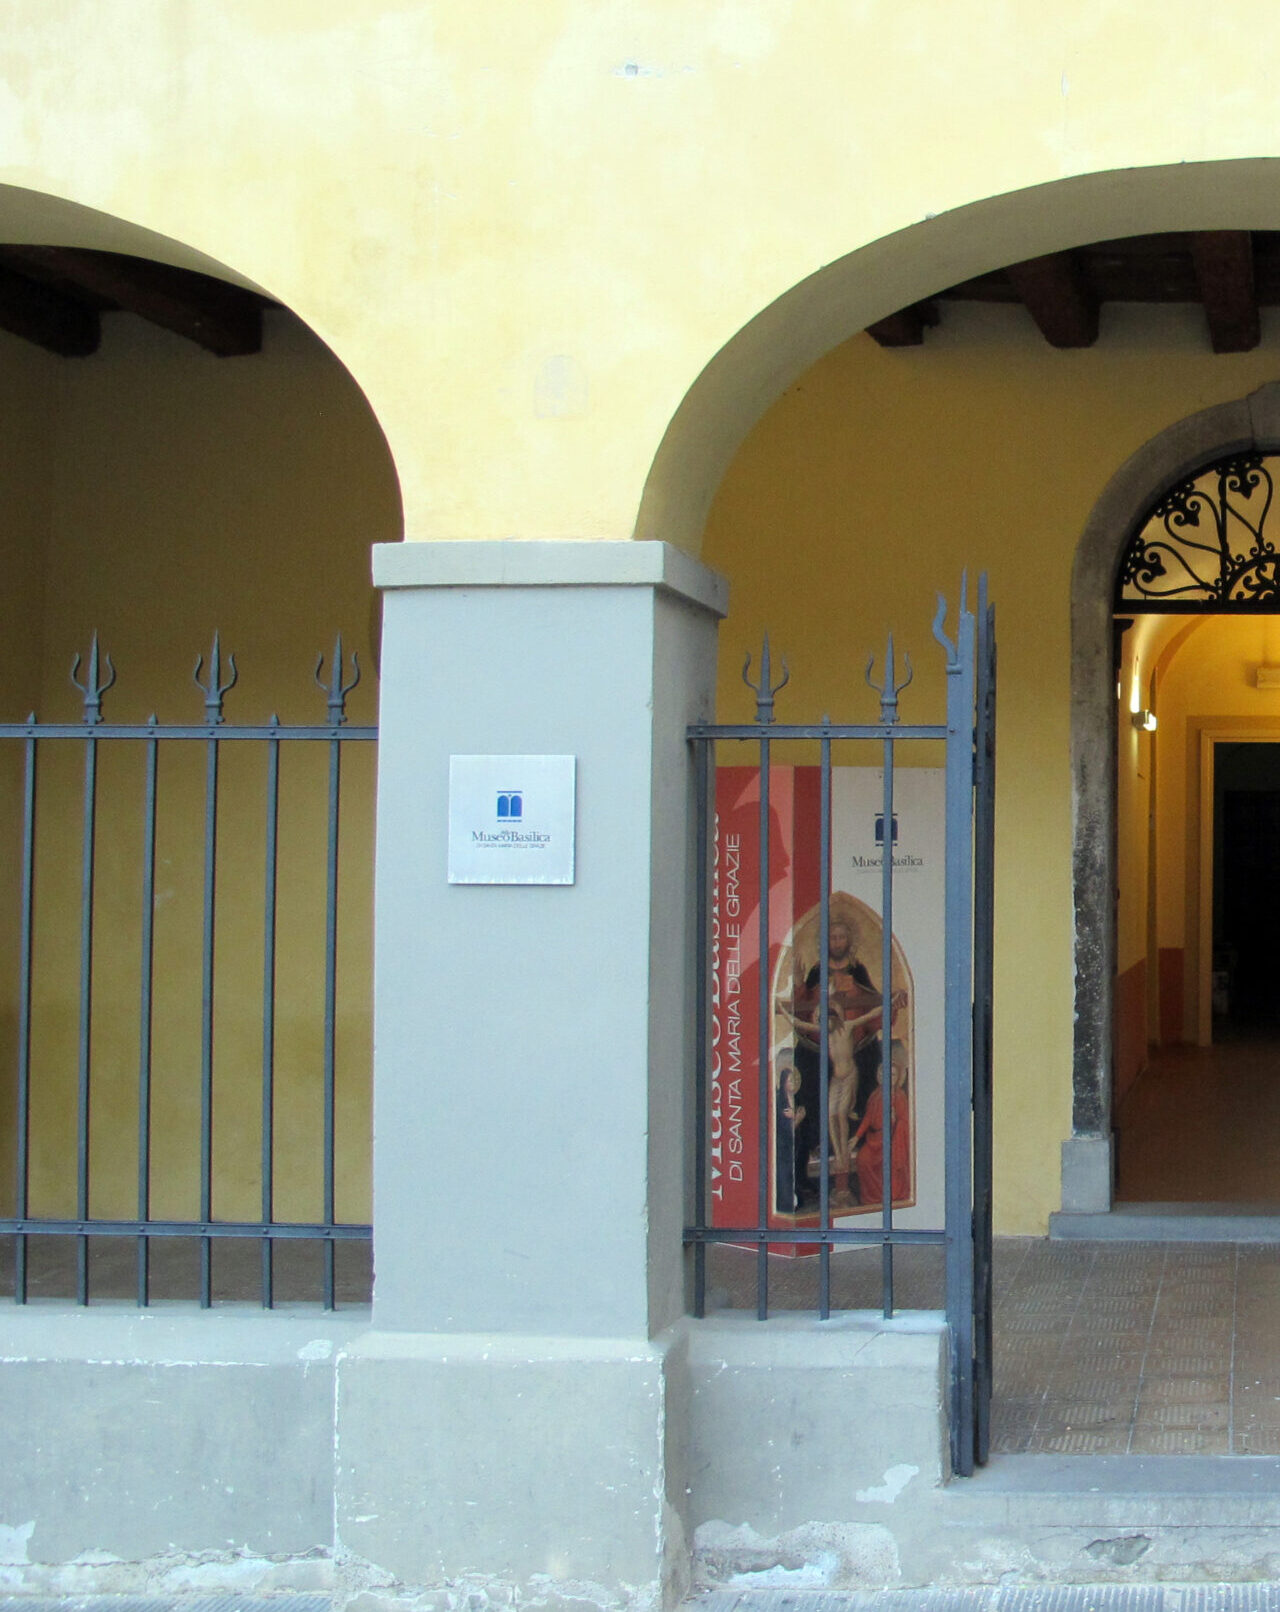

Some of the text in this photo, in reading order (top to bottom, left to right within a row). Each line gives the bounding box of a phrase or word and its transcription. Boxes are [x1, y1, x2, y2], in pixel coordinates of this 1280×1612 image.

[472, 831, 510, 842] Museo
[511, 831, 551, 842] Basilica
[726, 833, 743, 1181] DI SANTA MARIA DELLE GRAZIE
